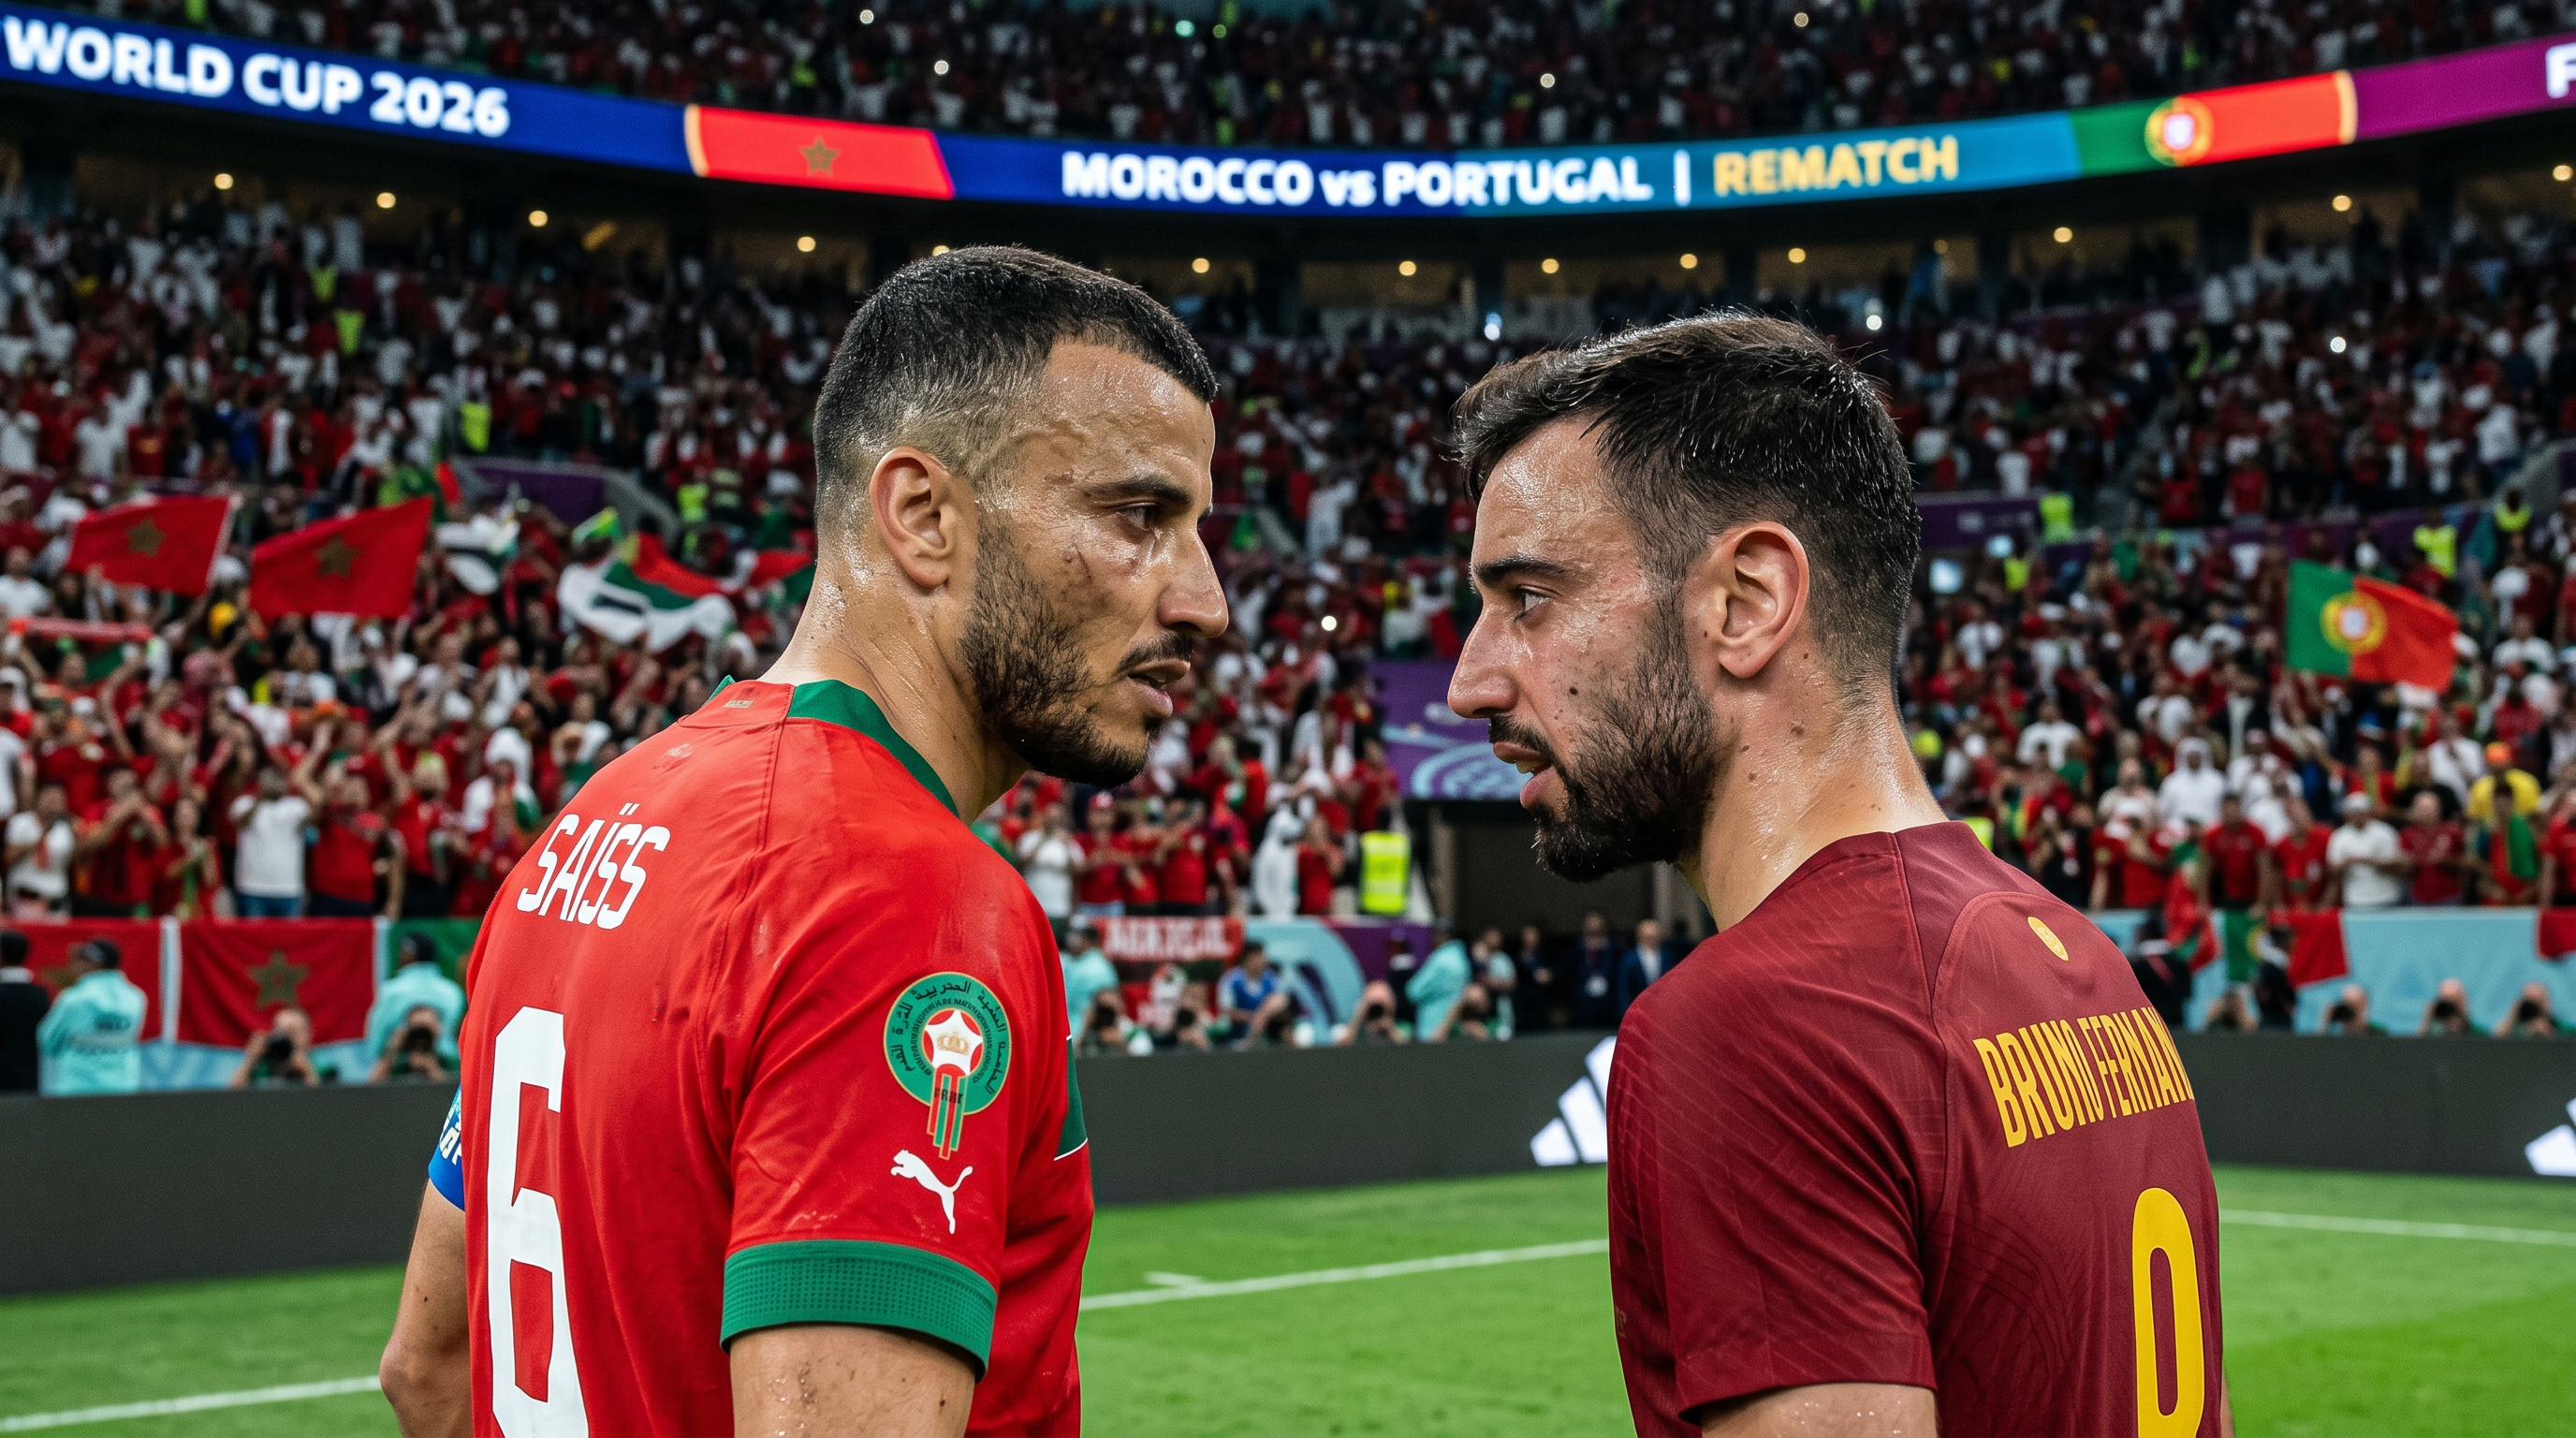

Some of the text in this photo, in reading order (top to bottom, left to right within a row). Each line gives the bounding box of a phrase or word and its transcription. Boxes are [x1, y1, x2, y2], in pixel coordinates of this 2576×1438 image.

[4, 17, 509, 138] WORLD CUP 2026
[1061, 151, 1314, 206] MOROCCO
[1319, 169, 1376, 207] vs
[1383, 155, 1653, 207] PORTUGAL
[1714, 136, 1959, 197] REMATCH
[1972, 1006, 2195, 1148] BRUNO FERNAN
[487, 1005, 590, 1438] 6
